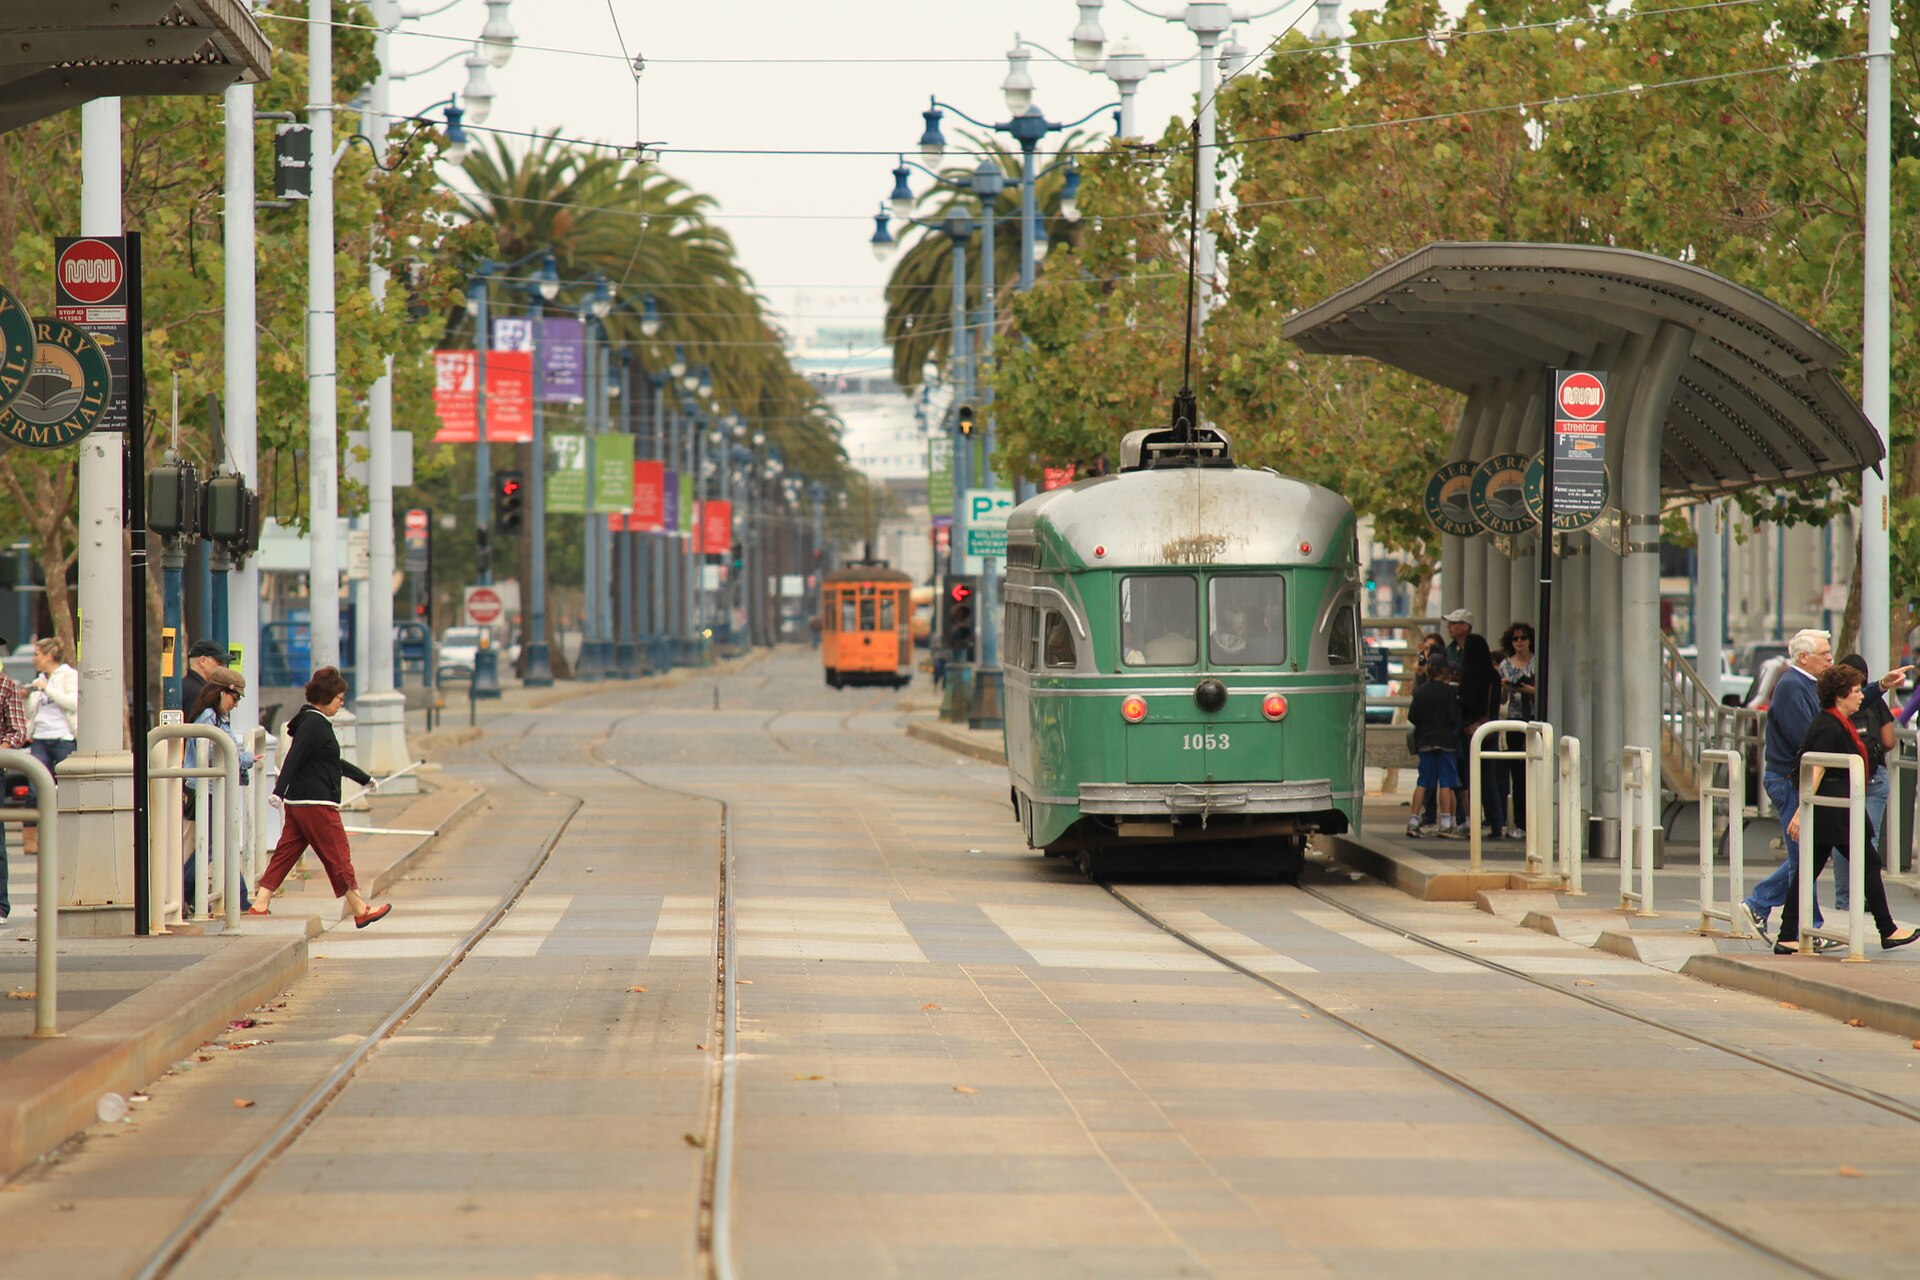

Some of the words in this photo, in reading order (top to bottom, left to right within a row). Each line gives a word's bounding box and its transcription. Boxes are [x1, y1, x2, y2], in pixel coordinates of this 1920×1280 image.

[65, 258, 116, 284] MUNI
[38, 323, 92, 356] RRY
[1563, 386, 1600, 406] MUNI
[0, 391, 104, 444] ERMINAL
[1562, 422, 1599, 432] streetcar
[1559, 434, 1566, 446] F
[1437, 463, 1477, 482] FER
[1483, 456, 1530, 476] FERR
[973, 496, 993, 521] P
[1476, 501, 1535, 532] TERMIN
[1429, 506, 1480, 535] TERMI
[1183, 733, 1230, 750] 1053
